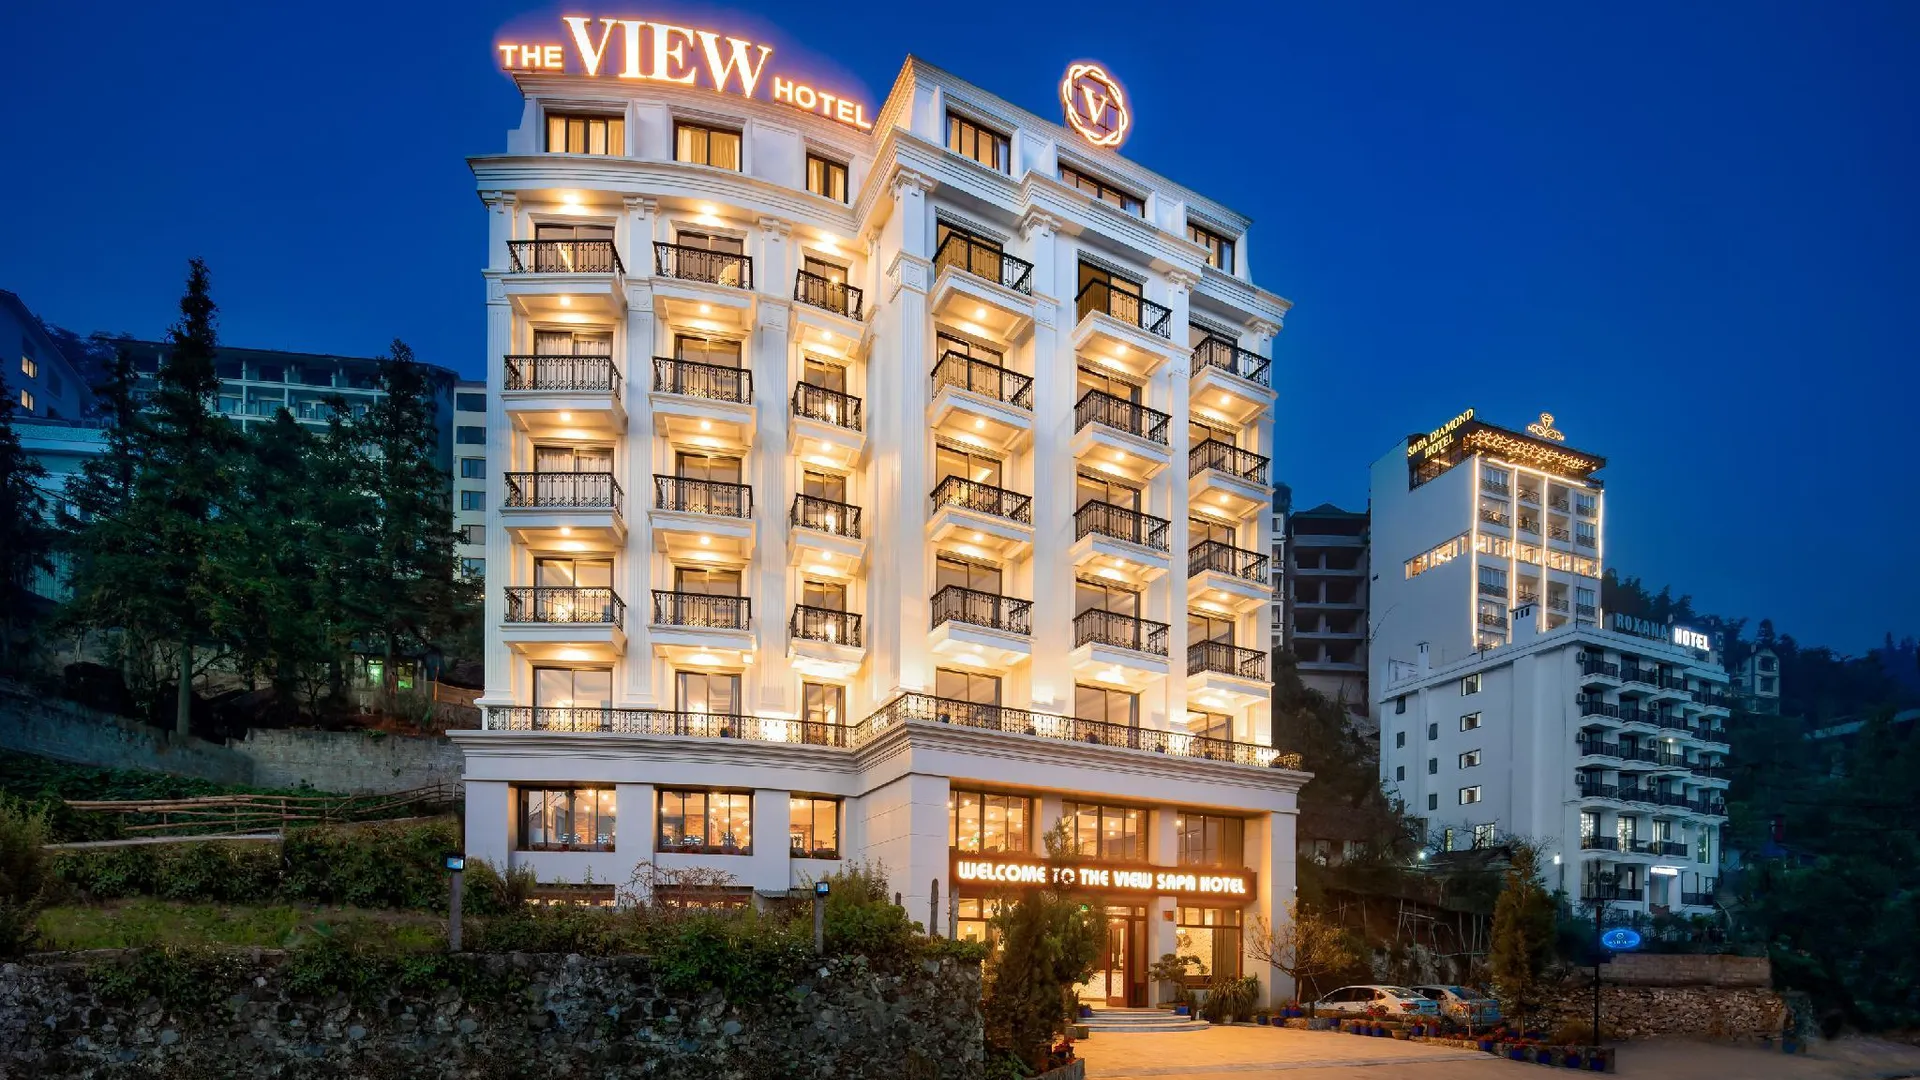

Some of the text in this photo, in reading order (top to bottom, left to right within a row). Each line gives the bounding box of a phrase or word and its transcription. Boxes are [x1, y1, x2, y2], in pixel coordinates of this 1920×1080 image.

[500, 15, 872, 129] THE VIEW HOTEL
[1082, 84, 1109, 124] V
[1408, 408, 1474, 457] SAPA DIAMOND
[1424, 433, 1454, 459] HOTEL
[1615, 612, 1710, 652] ROXANA HOTEL
[958, 861, 1246, 894] WELCOME TO THE VIEW SAPA HOTEL
